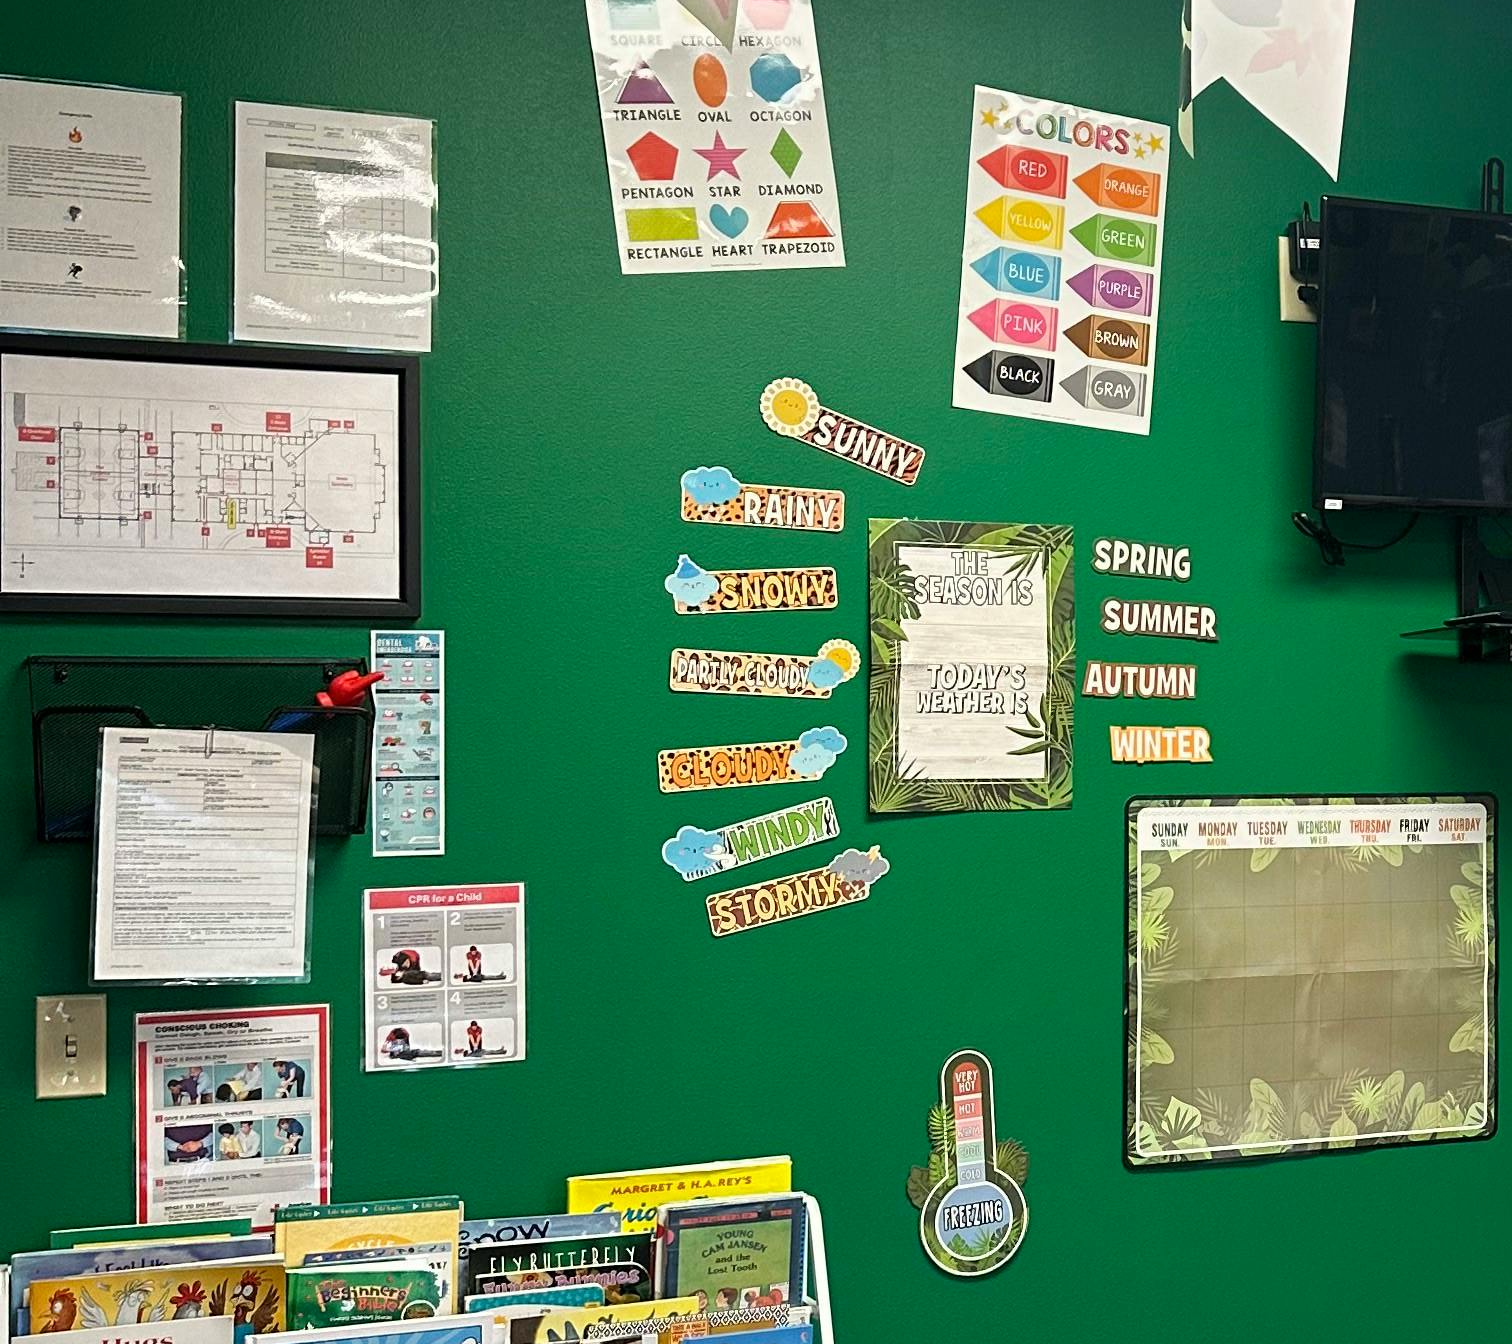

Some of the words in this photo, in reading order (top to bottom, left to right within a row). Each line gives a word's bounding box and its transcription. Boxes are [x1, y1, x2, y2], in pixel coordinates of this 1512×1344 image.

[681, 35, 726, 47] CIRCL
[739, 35, 802, 47] HEXAGON
[613, 109, 681, 121] TRIANGLE
[698, 111, 732, 123] OVAL
[750, 110, 812, 122] OCTAGON
[1015, 113, 1130, 155] COLORS
[1018, 160, 1048, 178] RED
[621, 186, 694, 199] PENTAGON
[709, 186, 741, 197] STAR
[758, 184, 823, 196] DIAMOND
[1103, 178, 1150, 199] ORANGE
[1009, 212, 1052, 231] YELLOW
[1101, 228, 1146, 249] GREEN
[627, 246, 703, 259] RECTANGLE
[712, 244, 753, 257] HEART
[761, 242, 835, 255] TRAPEZOID
[1008, 263, 1044, 283] BLUE
[1099, 280, 1141, 299] PURPLE
[1002, 316, 1043, 335] PINK
[1094, 330, 1139, 350] BROWN
[999, 365, 1040, 384] BLACK
[1093, 380, 1132, 399] GRAY
[812, 413, 917, 478] SUNNY
[743, 490, 837, 529] RAINY
[951, 551, 988, 576] THE
[1094, 540, 1191, 578] SPRING
[720, 574, 829, 610] SNOWY
[913, 576, 1003, 605] SEASON
[1011, 579, 1033, 606] IS
[1103, 600, 1216, 637] SUMMER
[676, 658, 739, 687] PARTLY
[744, 661, 810, 689] CLOUDY
[927, 663, 1026, 690] TODAY'S
[1086, 663, 1196, 697] AUTUMN
[916, 692, 1005, 714] WEATHER
[1009, 691, 1029, 714] IS
[1112, 728, 1211, 759] WINTER
[670, 748, 792, 788] CLOUDY
[729, 805, 825, 861] WINDY
[1152, 823, 1188, 838] SUNDAY
[1199, 822, 1237, 837] MONDAY
[1248, 821, 1288, 836] TUESDAY
[1297, 820, 1341, 835] WEDNESDAY
[1350, 819, 1391, 834] THURSDAY
[1399, 818, 1429, 833] FRIDAY
[1438, 818, 1480, 832] SATURDAY
[408, 893, 430, 905] CPR
[433, 893, 446, 903] for
[456, 891, 482, 902] Child
[715, 872, 838, 930] STORMY
[955, 1070, 978, 1083] VERY
[959, 1081, 975, 1093] HOT
[959, 1103, 975, 1114] HOT
[611, 1183, 673, 1195] MARGRET
[677, 1182, 686, 1190] &
[943, 1199, 1003, 1231] FREEZING
[717, 1230, 754, 1241] YOUNG
[702, 1244, 725, 1258] CAM
